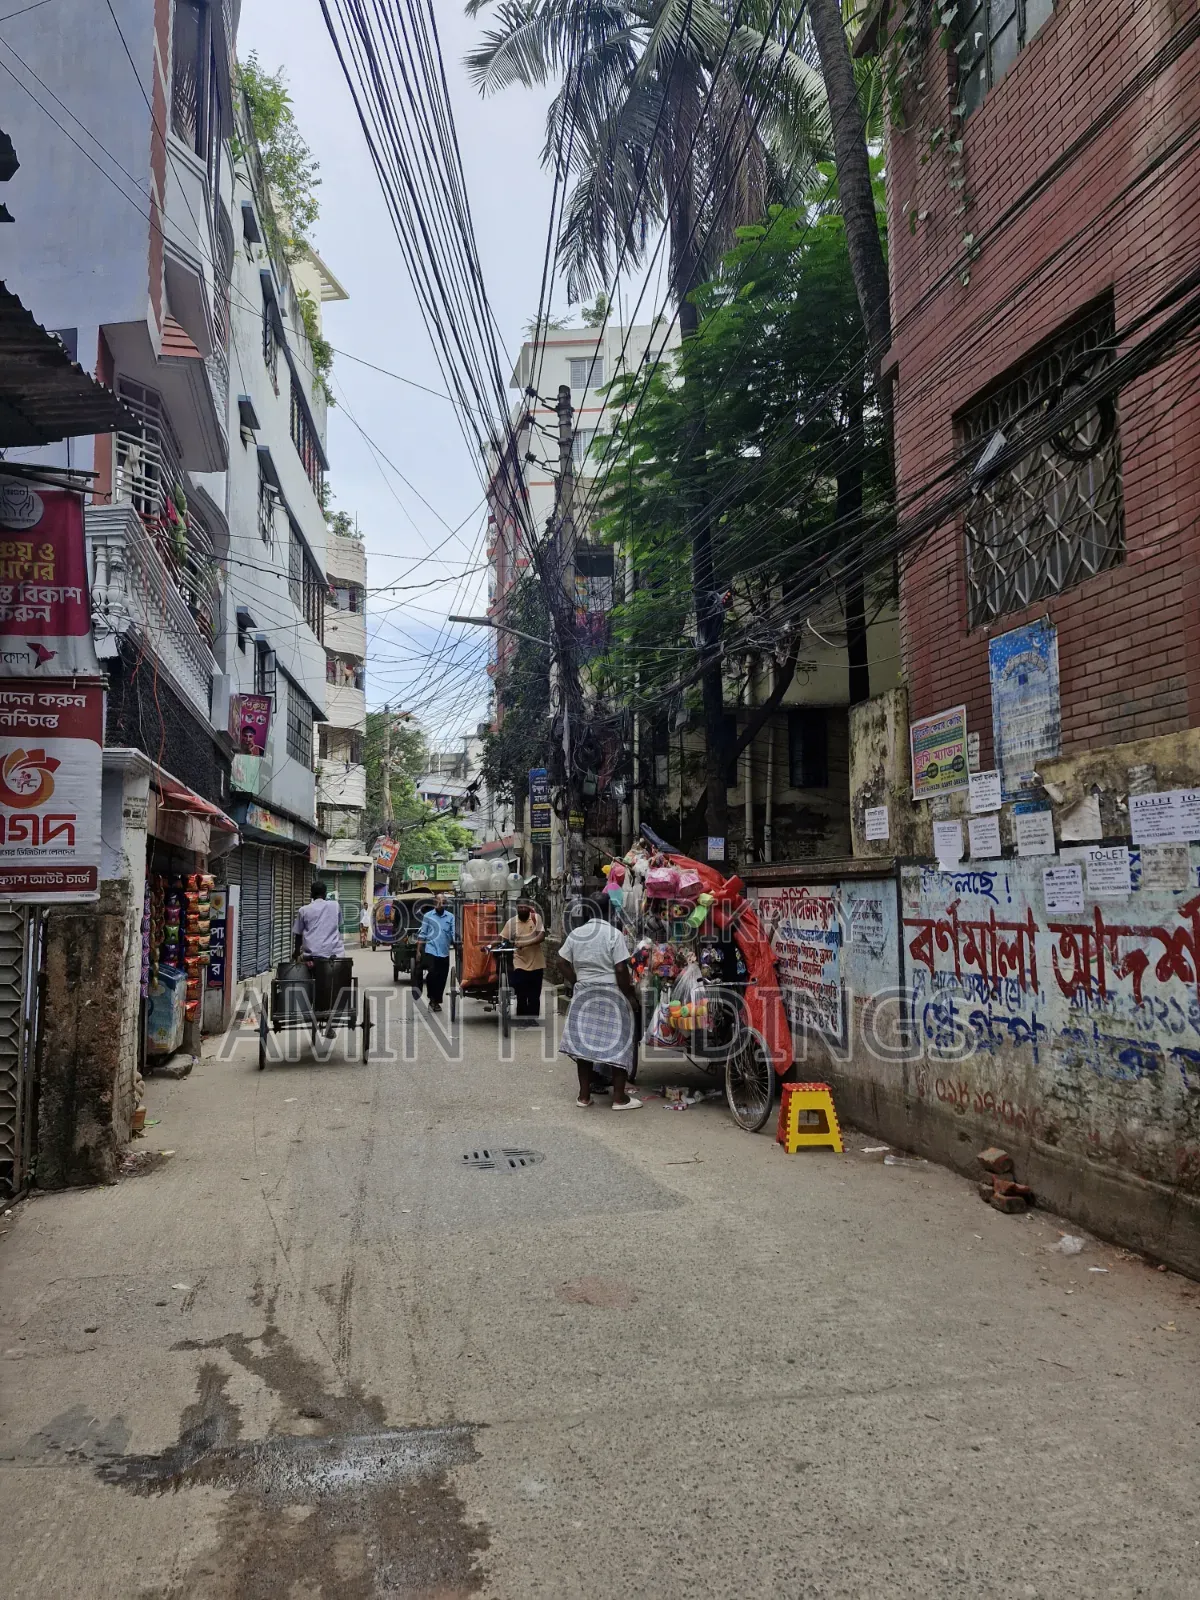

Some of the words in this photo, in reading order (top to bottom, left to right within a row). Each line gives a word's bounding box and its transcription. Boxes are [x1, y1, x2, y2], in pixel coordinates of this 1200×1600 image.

[38, 543, 55, 561] ও
[19, 580, 82, 605] বিকাশ
[38, 693, 87, 708] করুন
[1134, 796, 1172, 807] TO-LET
[17, 847, 47, 856] ডিজিটাল
[1089, 848, 1124, 860] TO-LET
[29, 871, 64, 884] আউট
[66, 870, 91, 884] চার্জ
[903, 898, 1040, 997] বর্ণমালা
